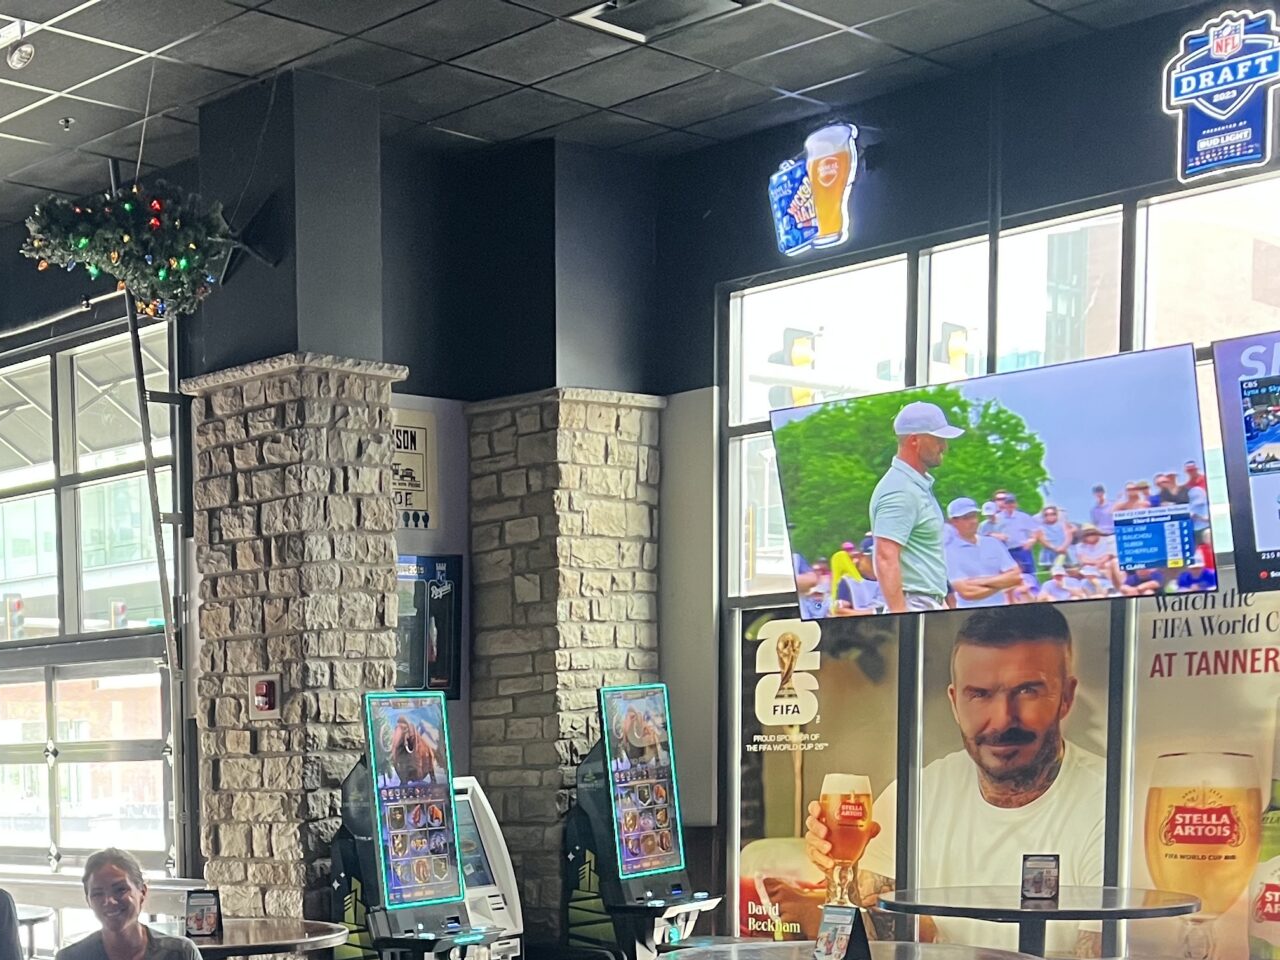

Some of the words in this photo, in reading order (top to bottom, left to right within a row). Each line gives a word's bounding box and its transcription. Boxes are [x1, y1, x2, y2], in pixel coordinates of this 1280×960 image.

[1215, 38, 1238, 54] NFL
[1180, 54, 1274, 95] DRAFT
[1212, 89, 1238, 103] 2023
[1198, 136, 1220, 149] BUD
[1220, 130, 1251, 146] LIGHT
[392, 429, 417, 451] SON
[1155, 591, 1217, 613] Watch
[1222, 588, 1256, 609] the
[1152, 616, 1193, 640] FIFA
[1200, 612, 1260, 636] World
[1150, 652, 1177, 678] AT
[1184, 647, 1280, 677] TANNER
[772, 704, 801, 716] FIFA
[753, 734, 775, 742] PROUD
[745, 744, 759, 753] THE
[759, 744, 773, 752] FIFA
[773, 743, 798, 752] WORLD
[800, 742, 814, 751] CUP
[1174, 812, 1231, 825] STELLA
[1173, 825, 1231, 837] ARTOIS
[1180, 854, 1207, 862] WORLD
[748, 901, 780, 917] David
[748, 917, 801, 934] Beckham
